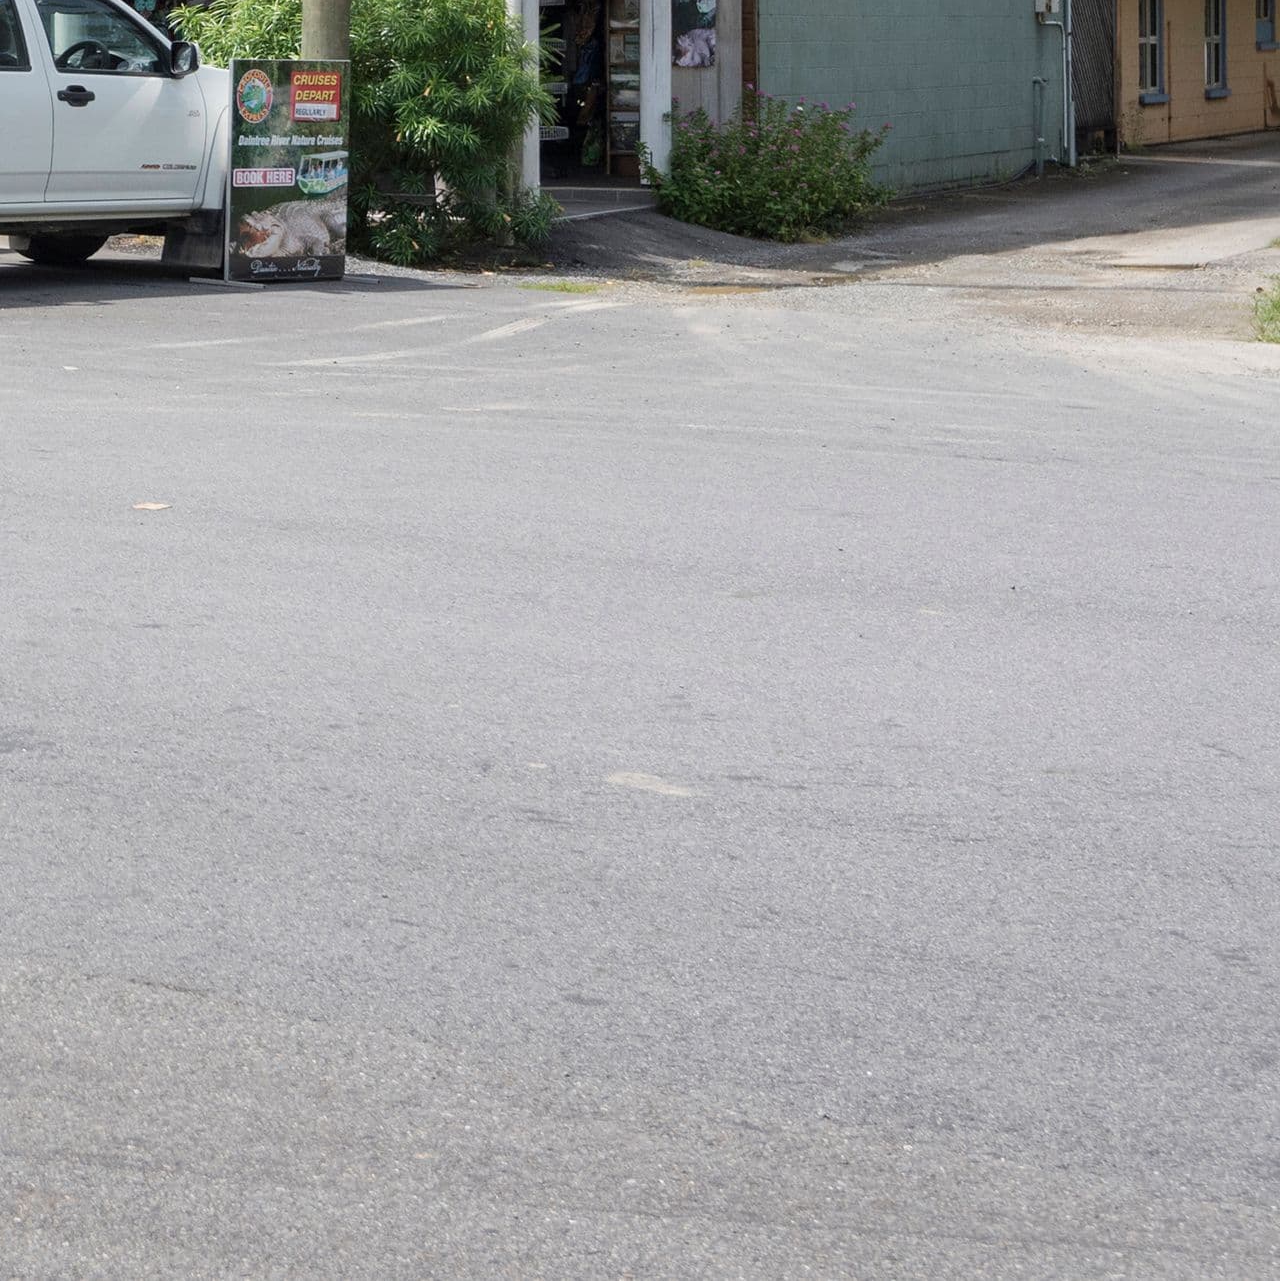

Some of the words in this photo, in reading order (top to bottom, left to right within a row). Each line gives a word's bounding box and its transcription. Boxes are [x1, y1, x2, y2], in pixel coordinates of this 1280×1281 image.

[293, 74, 338, 86] CRUISES
[295, 90, 336, 101] DEPART
[238, 134, 270, 146] Daintree
[270, 134, 291, 145] River
[291, 134, 316, 146] Nature
[317, 134, 343, 146] Cruises
[236, 171, 263, 184] BOOK
[266, 170, 292, 183] HERE
